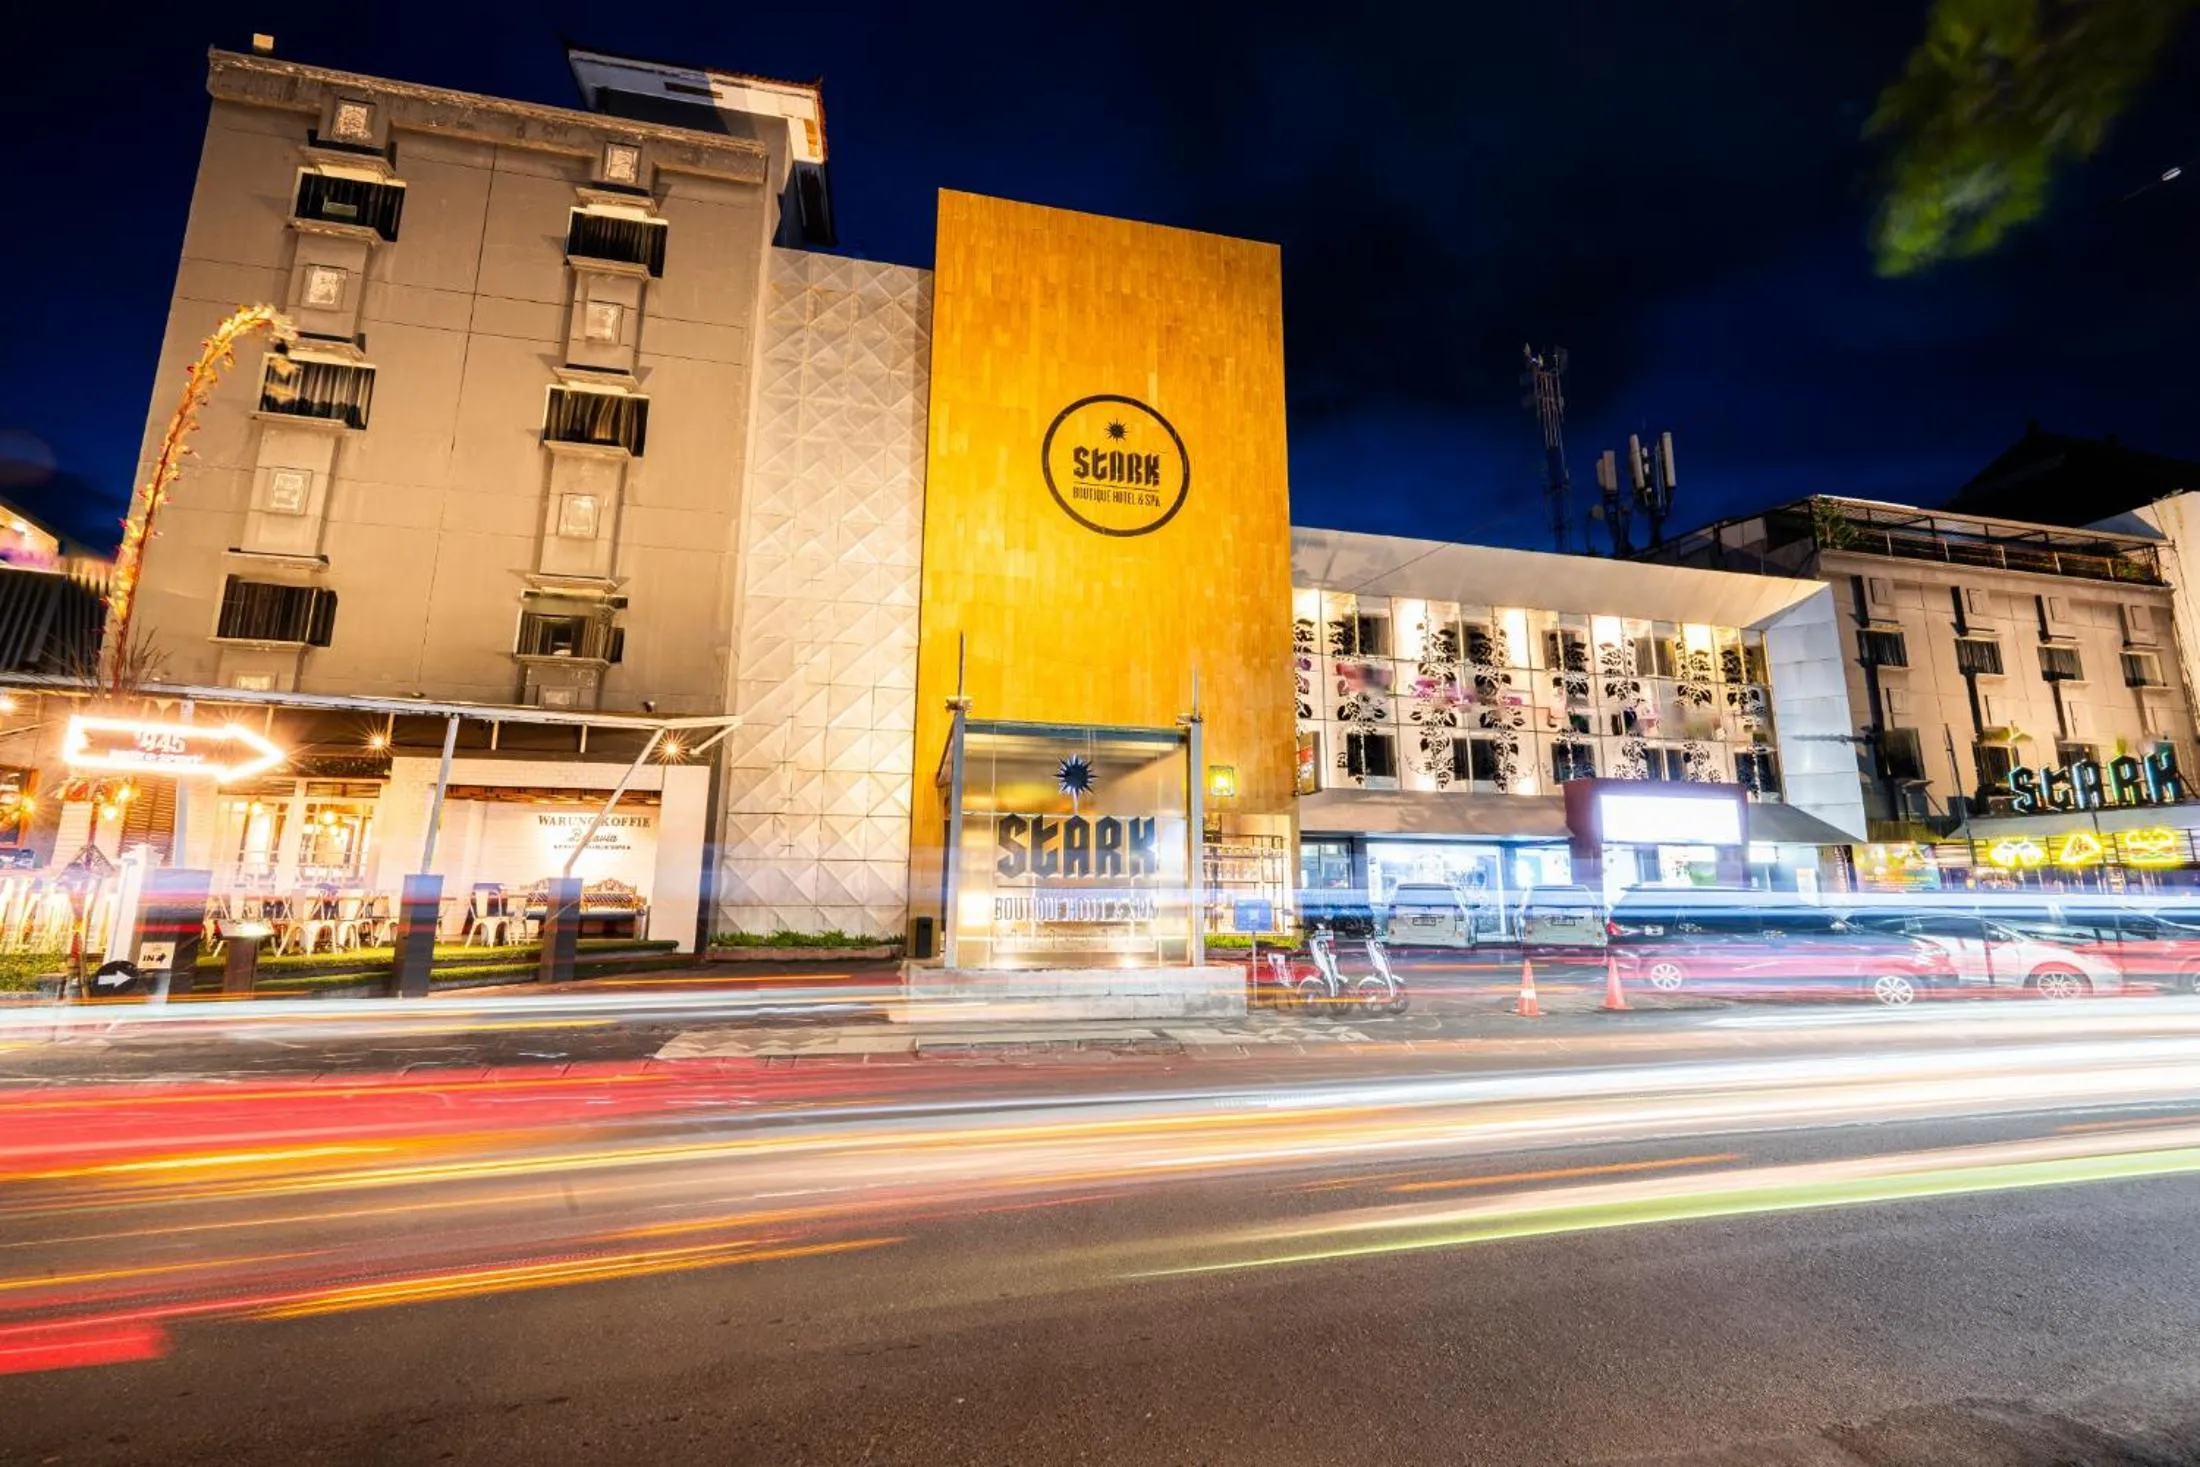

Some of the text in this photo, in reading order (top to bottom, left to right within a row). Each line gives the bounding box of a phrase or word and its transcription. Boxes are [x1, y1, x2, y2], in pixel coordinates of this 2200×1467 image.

[1073, 486, 1160, 507] BOUTIQUE HOTEL & SPA
